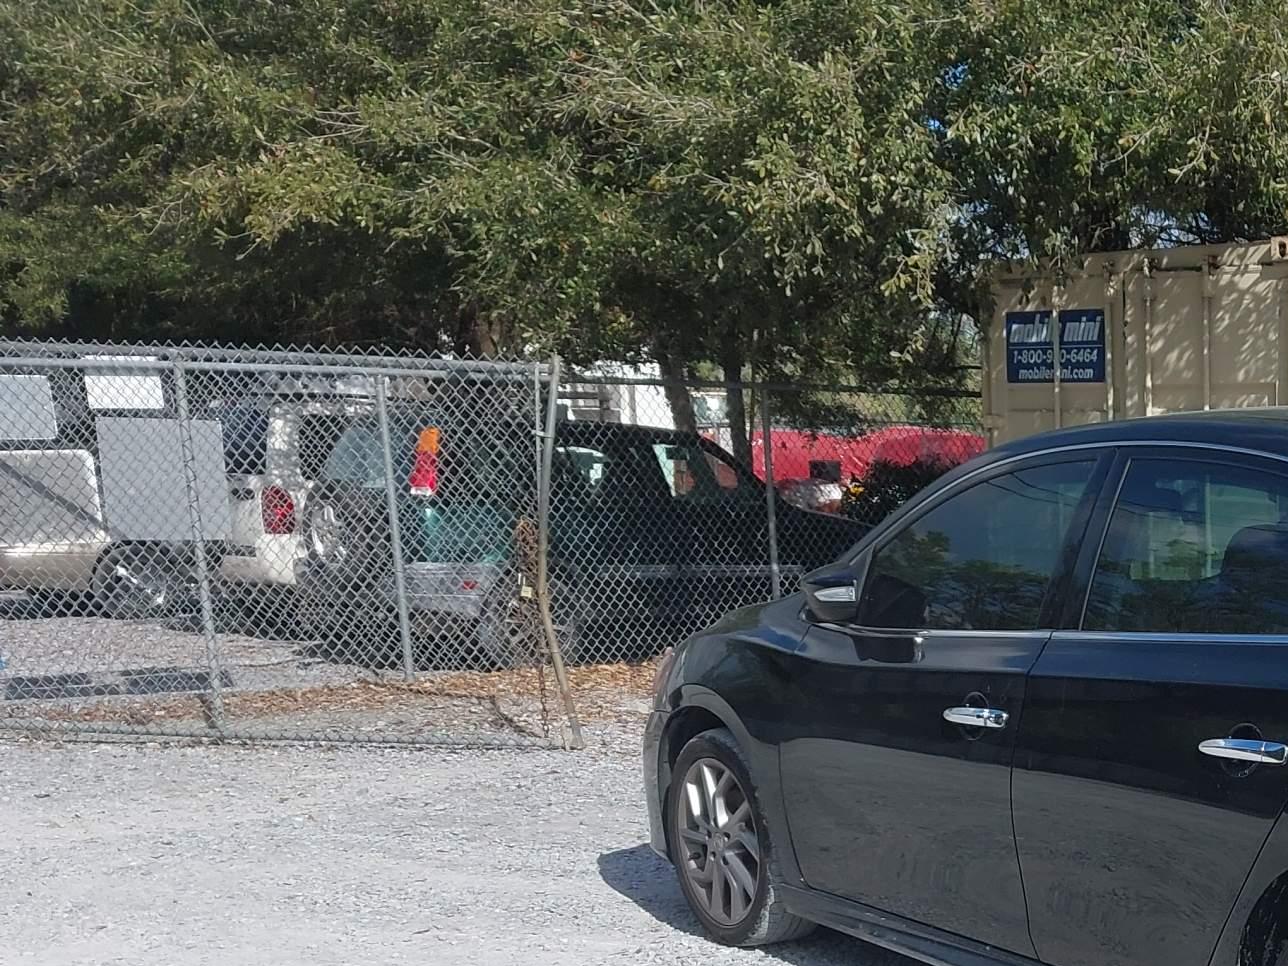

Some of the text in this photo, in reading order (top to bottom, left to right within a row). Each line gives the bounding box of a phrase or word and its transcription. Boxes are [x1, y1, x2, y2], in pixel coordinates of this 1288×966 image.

[1010, 314, 1101, 342] mobil mini
[1013, 348, 1098, 364] 1-800-90-6464
[1018, 366, 1094, 380] mobileni.com
